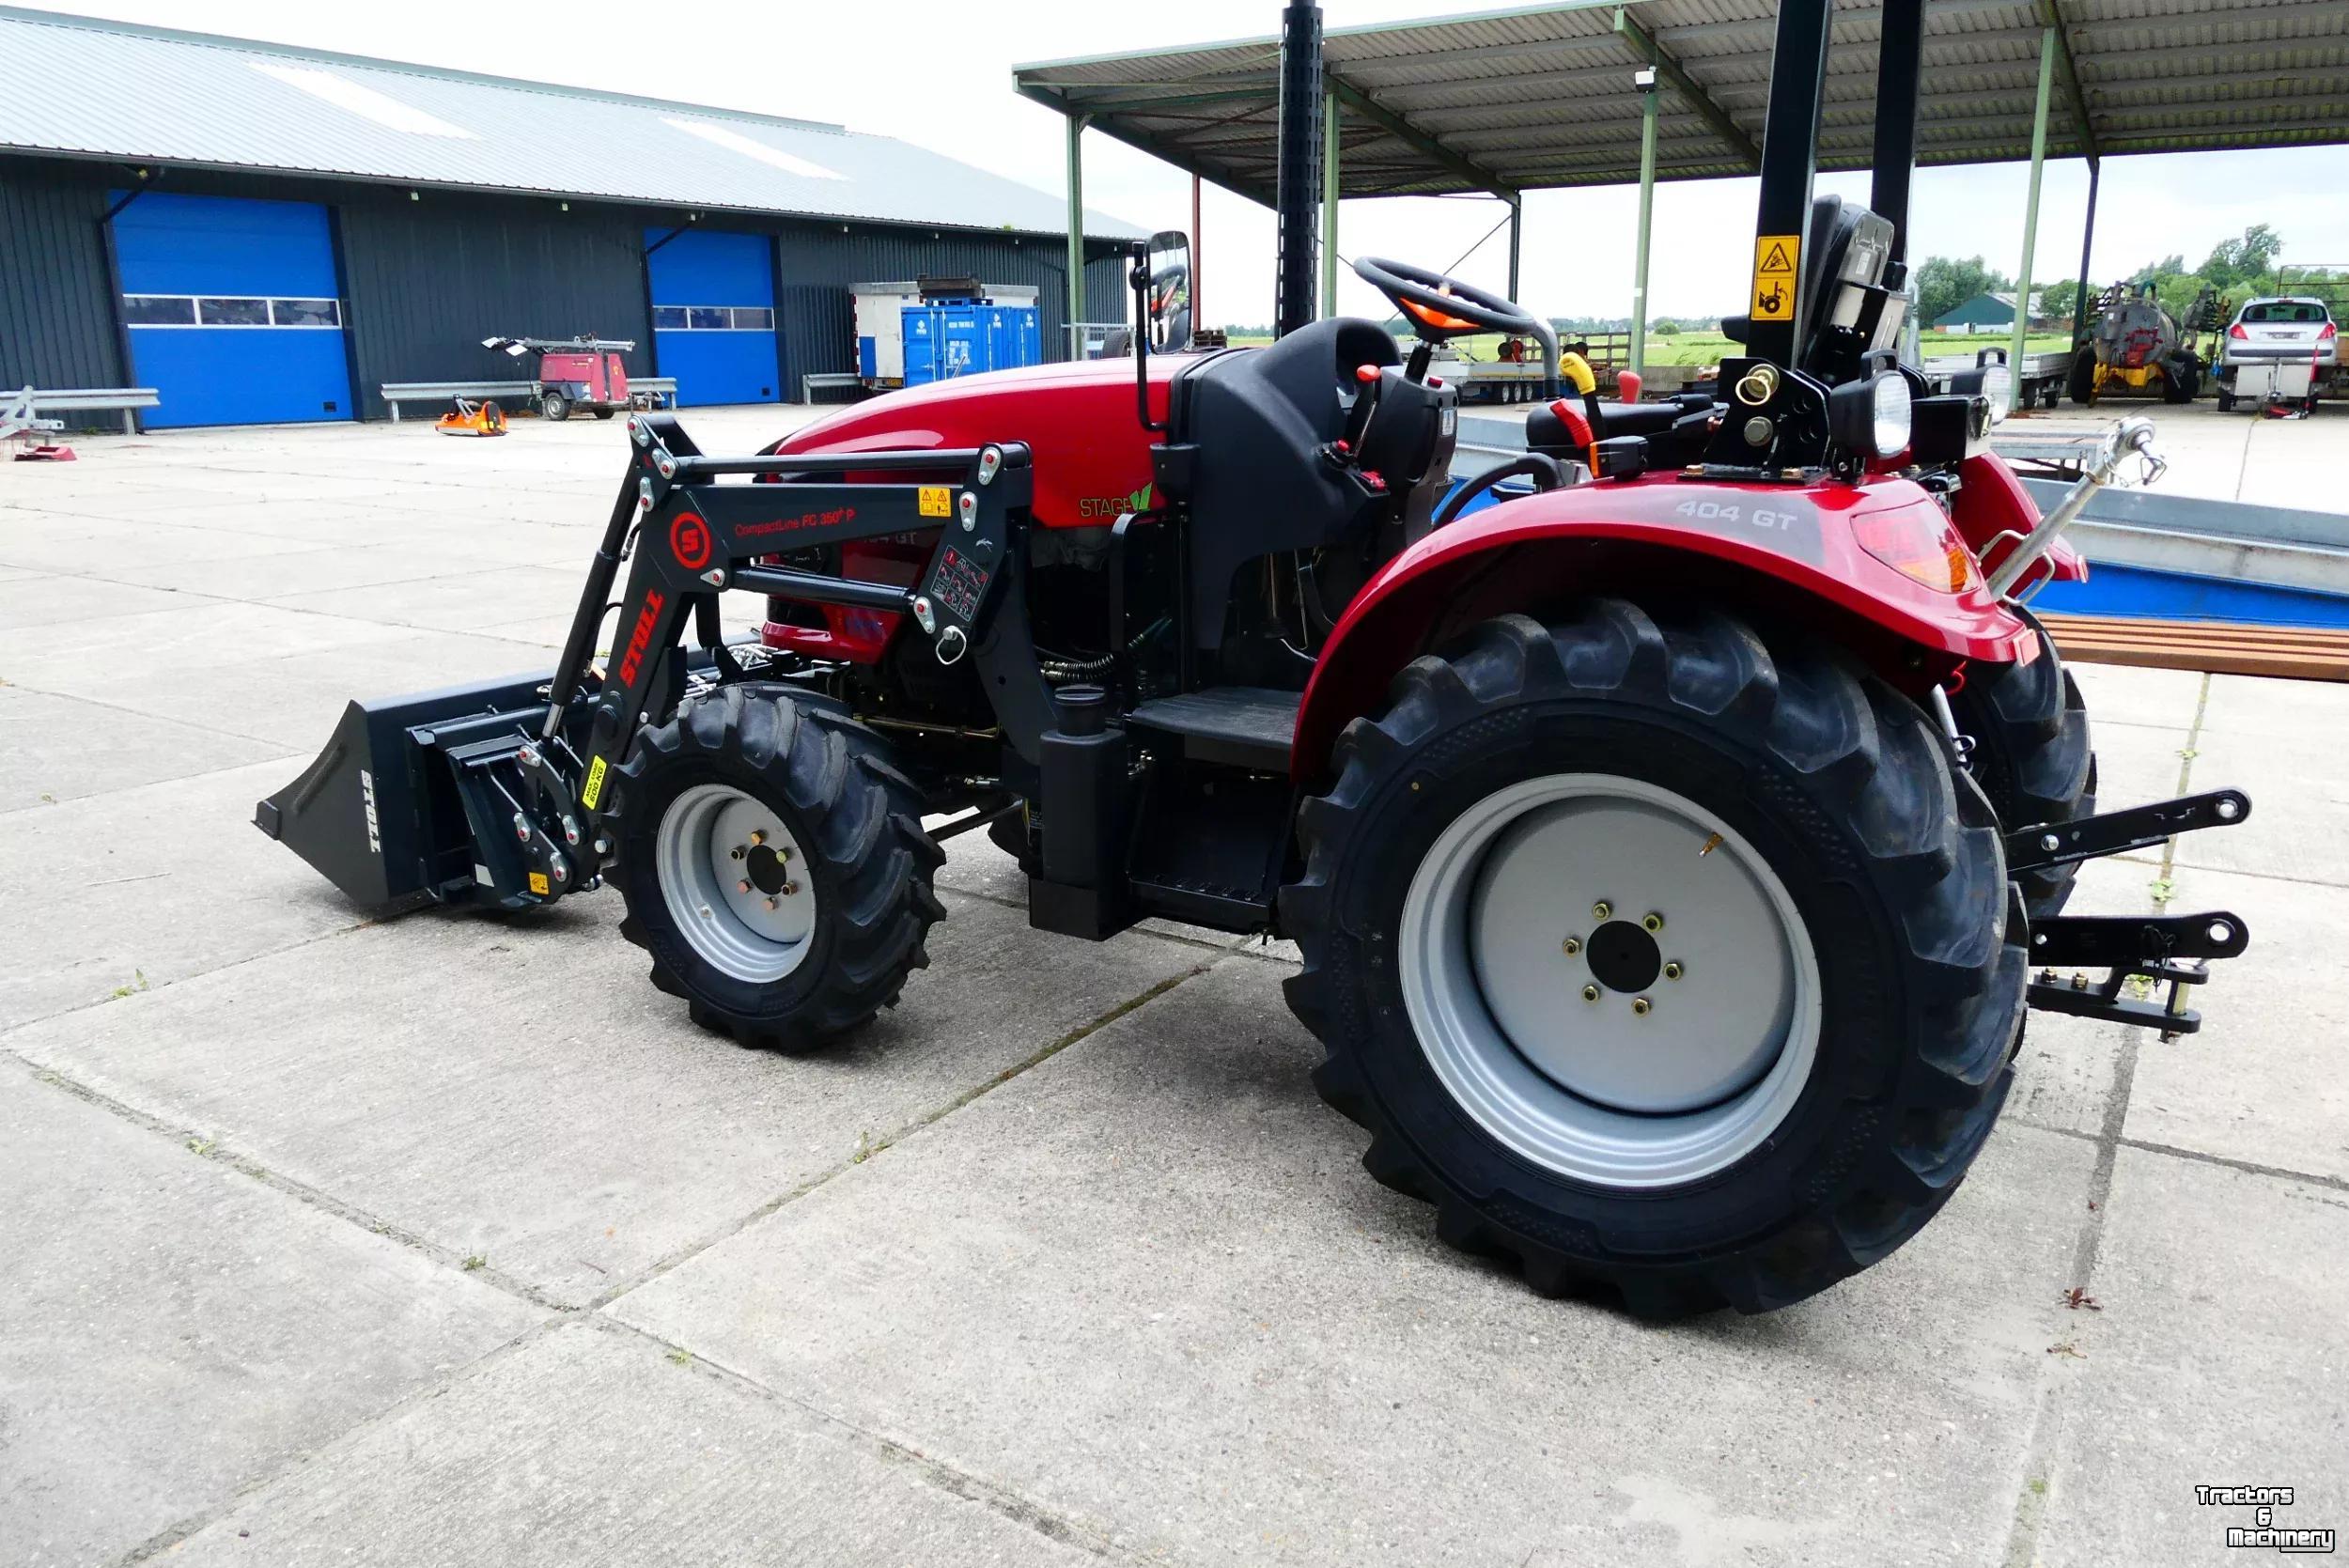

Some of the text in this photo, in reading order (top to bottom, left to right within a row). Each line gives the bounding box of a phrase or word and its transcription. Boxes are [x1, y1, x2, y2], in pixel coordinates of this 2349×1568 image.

[735, 519, 799, 536] CompactLine
[1675, 501, 1797, 530] 404 GT
[619, 588, 665, 689] STOLL
[596, 766, 604, 782] KG
[361, 768, 381, 853] STOLL
